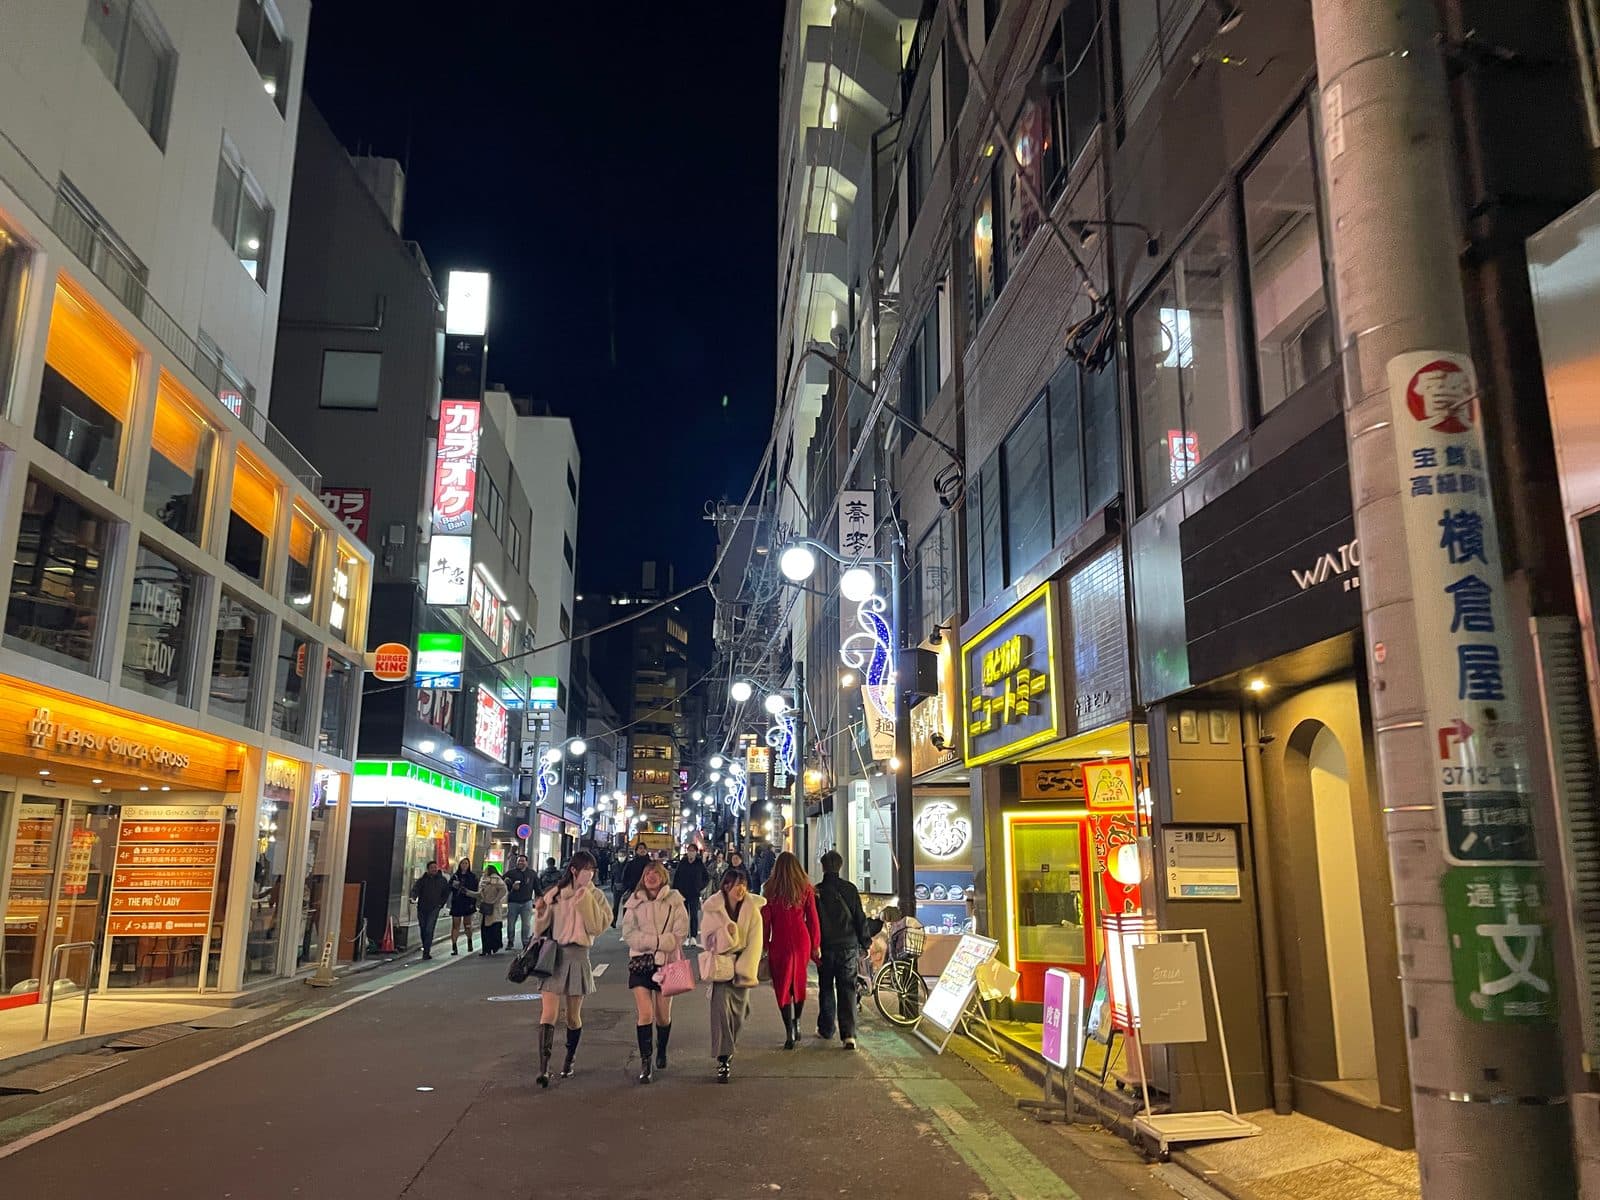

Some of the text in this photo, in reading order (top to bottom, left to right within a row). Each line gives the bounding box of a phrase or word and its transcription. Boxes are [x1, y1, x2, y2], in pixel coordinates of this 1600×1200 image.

[440, 404, 476, 514] カラオケ
[1438, 508, 1505, 701] 横倉屋
[144, 637, 177, 678] LADY
[376, 654, 408, 663] BURGER
[375, 661, 408, 673] KING
[56, 723, 191, 769] EBISU GINZA CROSS
[123, 828, 133, 836] 5F
[120, 851, 130, 859] 4F
[114, 897, 180, 906] 2F THE PIG LADY
[112, 922, 121, 930] 1F
[1475, 912, 1551, 996] 文
